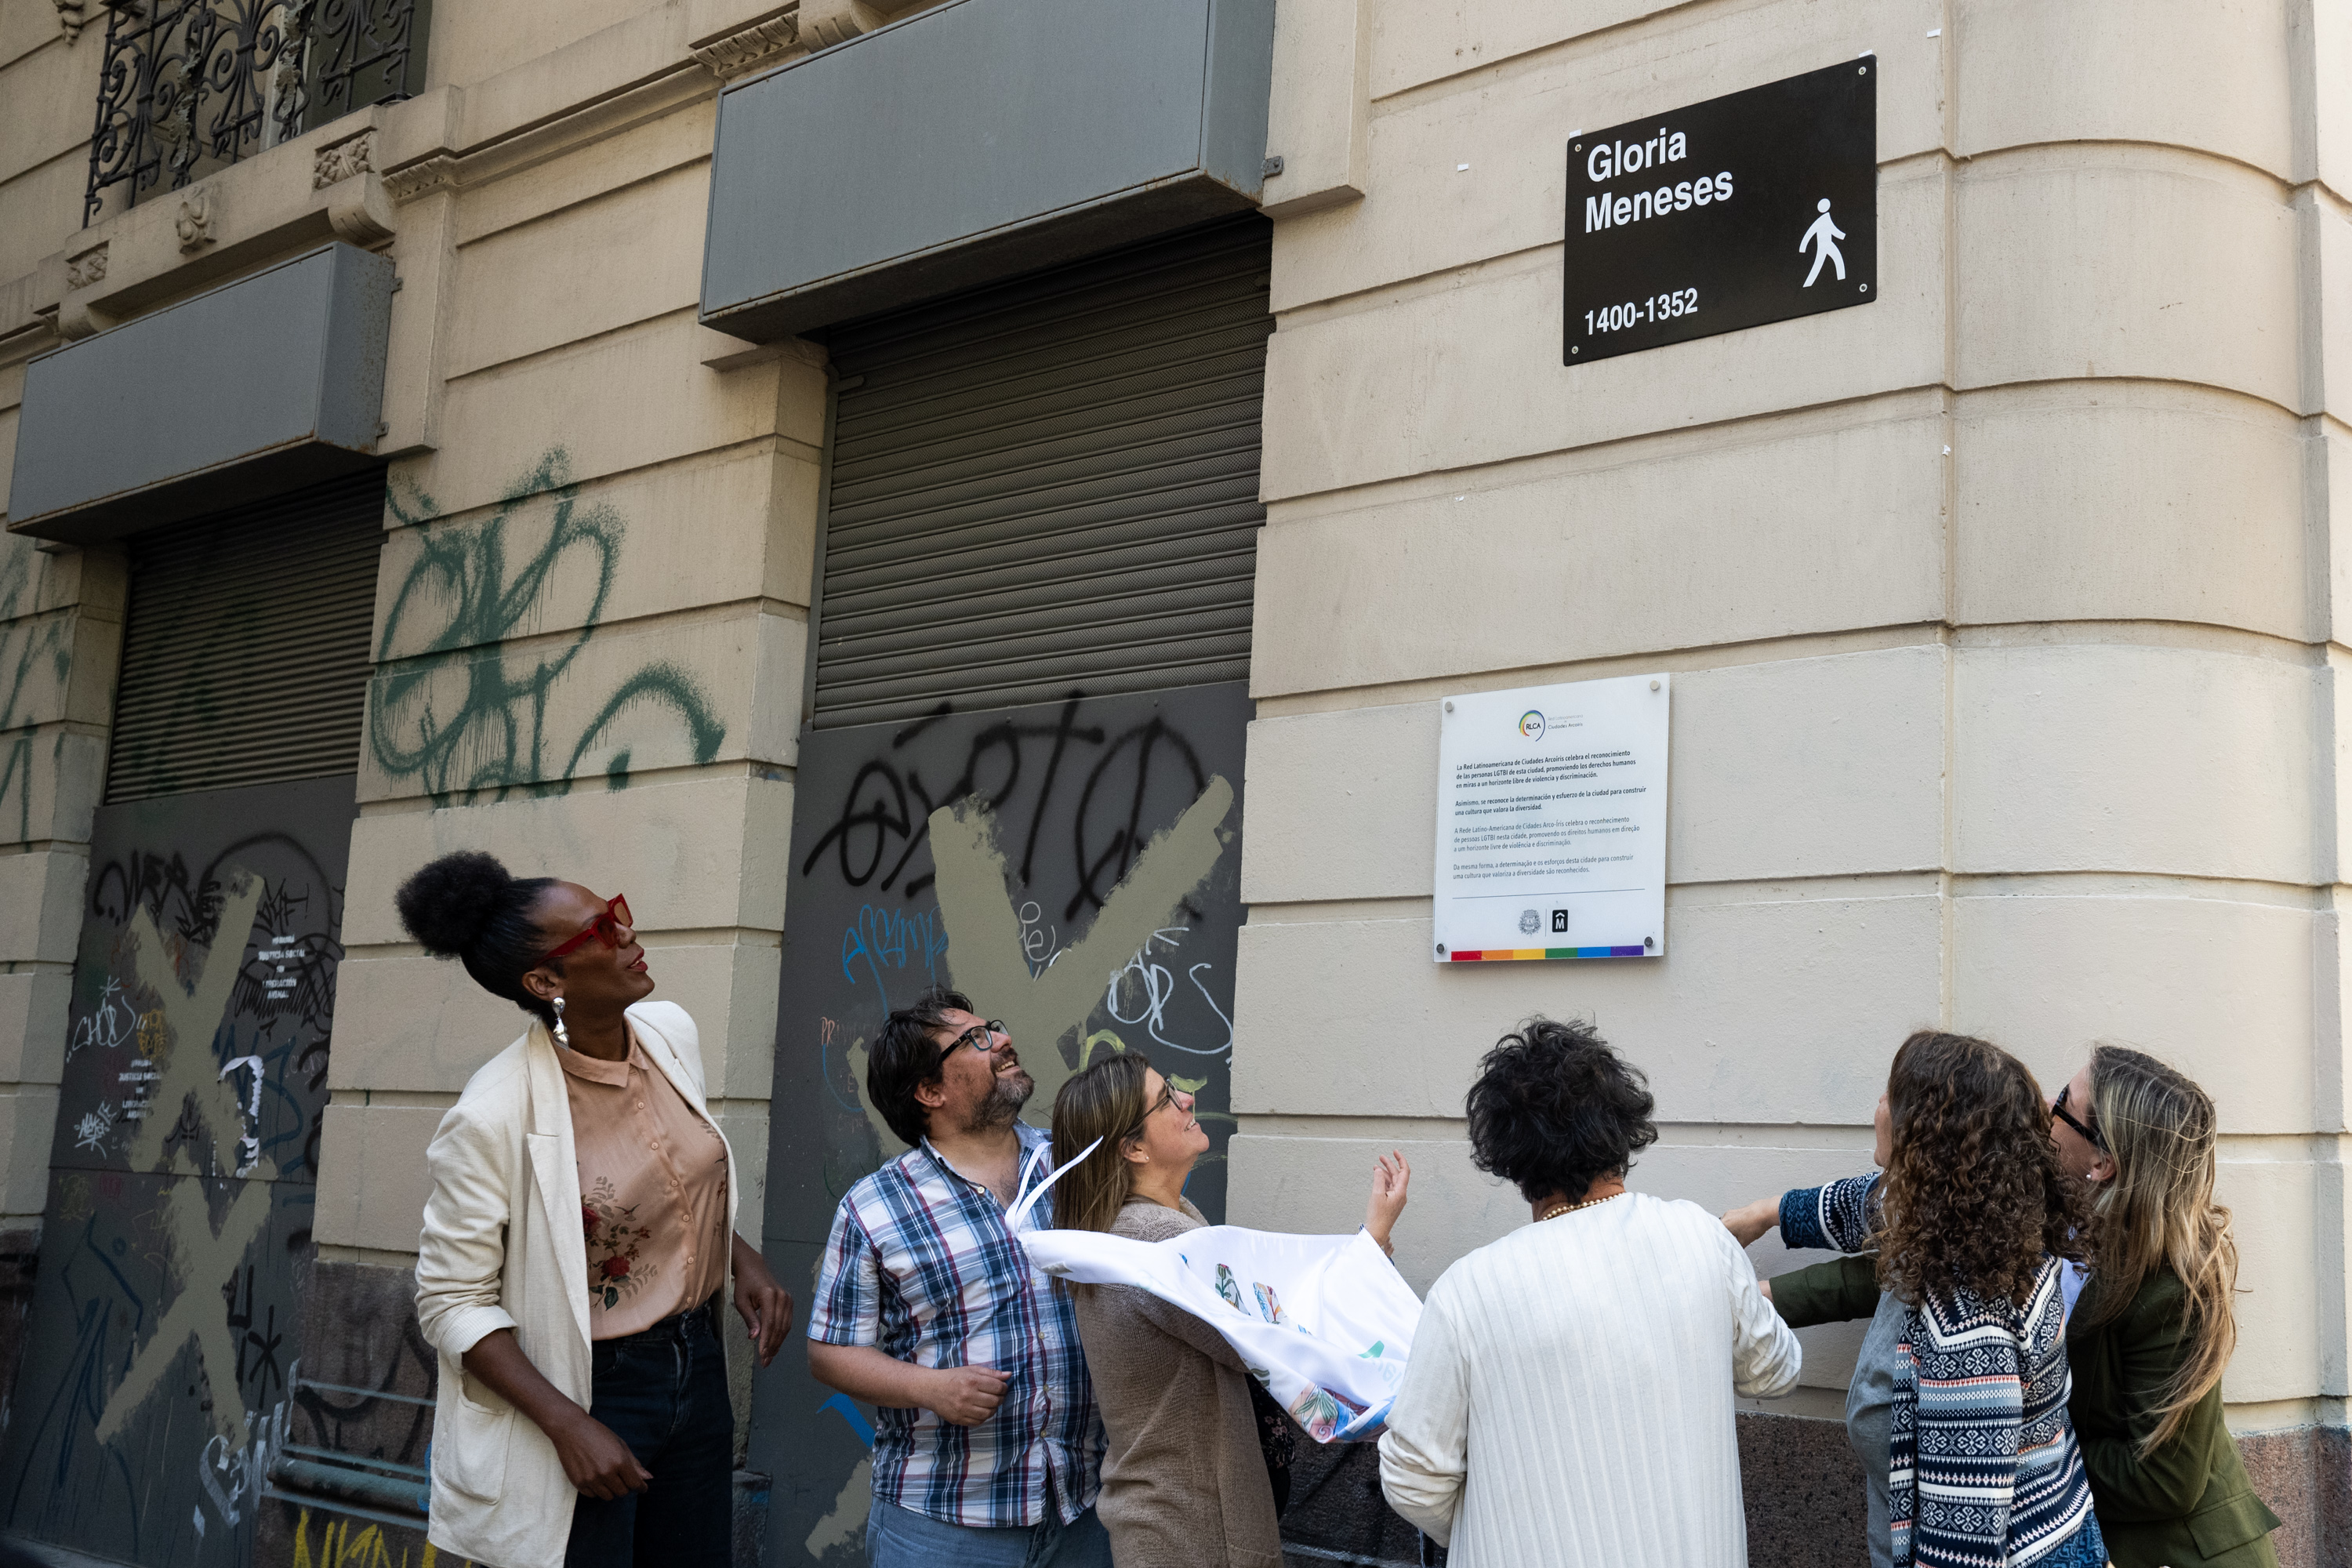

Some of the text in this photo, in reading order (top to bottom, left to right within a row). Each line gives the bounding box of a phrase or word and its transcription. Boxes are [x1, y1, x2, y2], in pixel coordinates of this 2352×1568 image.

[1587, 127, 1687, 183] Gloria
[1585, 171, 1734, 234] Meneses
[1585, 287, 1698, 336] 1400-1352
[1474, 760, 1513, 769] Latinoamericana
[1591, 750, 1630, 759] reconocimiento
[1471, 771, 1493, 780] personas
[1546, 763, 1579, 774] promoviendo
[1588, 760, 1611, 769] derechos
[1559, 771, 1598, 780] discriminación.
[1515, 793, 1551, 802] determinación
[1623, 786, 1646, 794] construir
[1515, 803, 1542, 811] diversidad.
[1472, 824, 1515, 833] Latino-Americana
[1543, 819, 1564, 828] Arco-Íris
[1589, 816, 1630, 825] reconhecimento
[1529, 829, 1559, 840] promovendo
[1621, 825, 1639, 833] direção
[1536, 839, 1571, 848] discriminação.
[1499, 859, 1532, 868] determinação
[1544, 858, 1565, 866] esforços
[1610, 853, 1634, 862] construir
[1516, 868, 1544, 877] diversidade
[1555, 866, 1590, 874] reconhecidos.
[1555, 916, 1565, 930] M
[285, 948, 305, 958] SOCIAL
